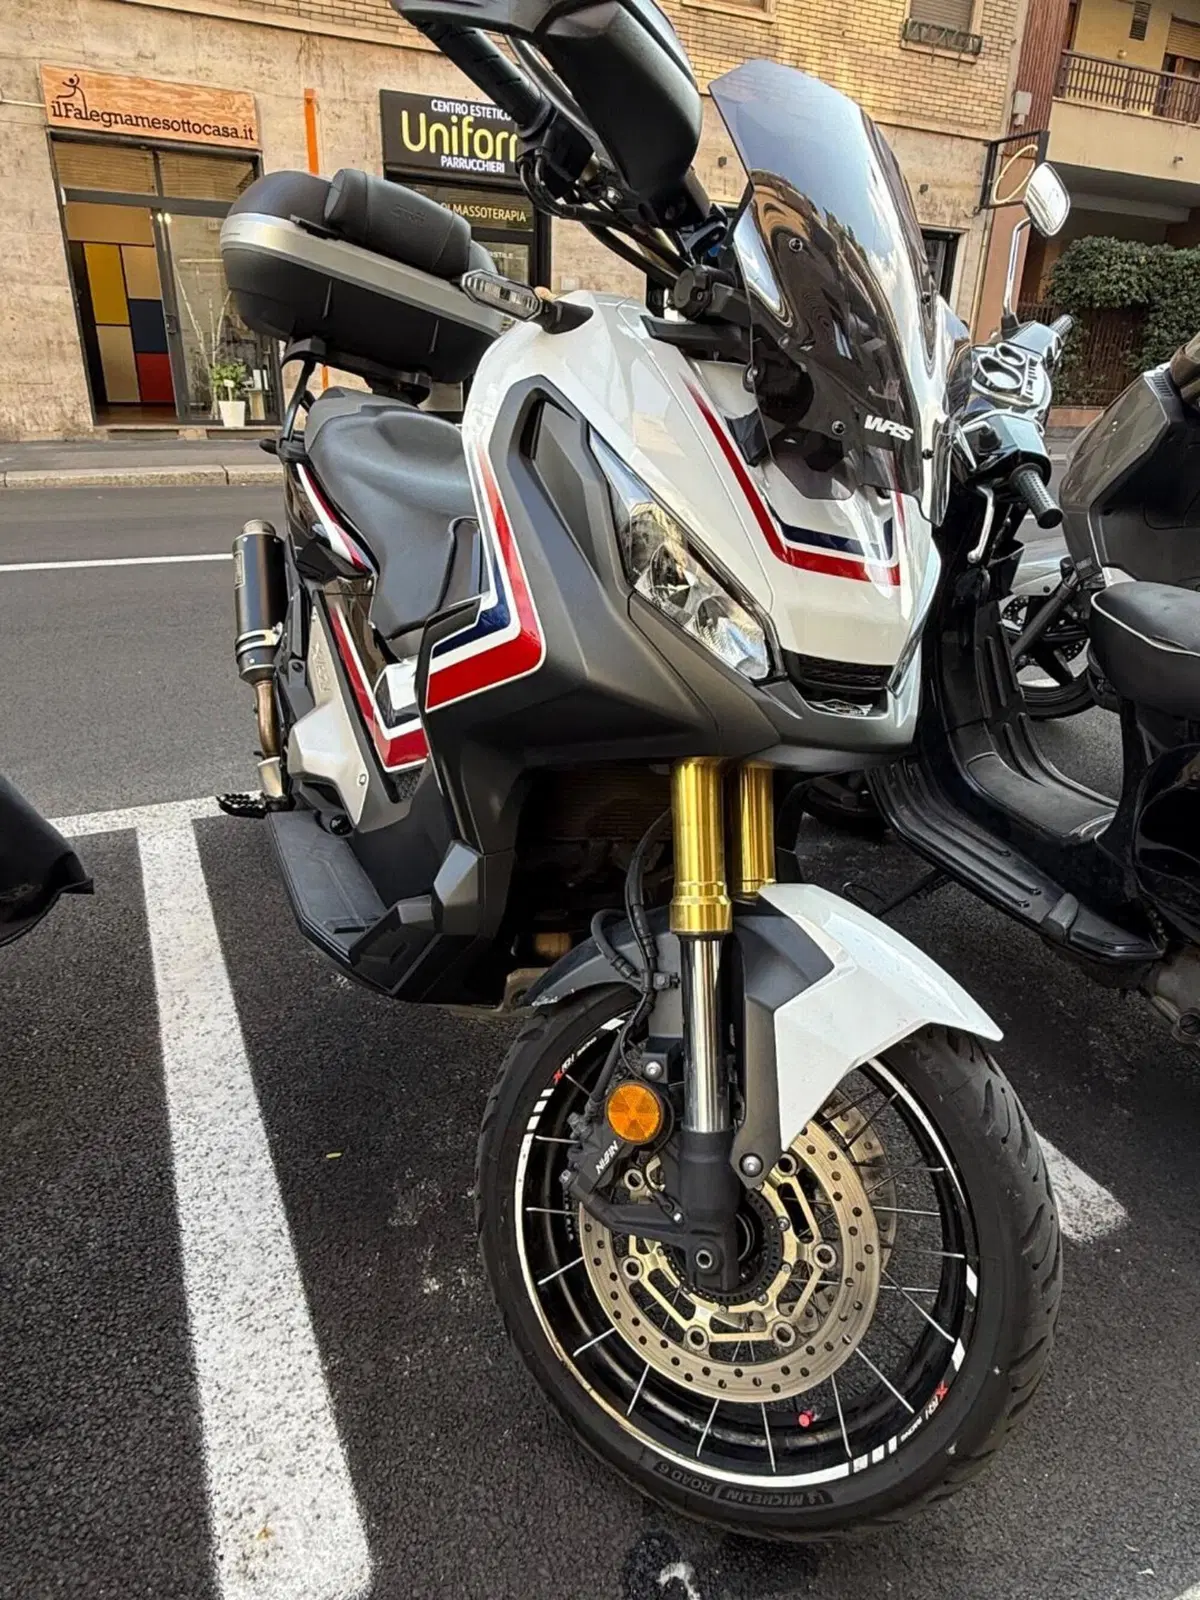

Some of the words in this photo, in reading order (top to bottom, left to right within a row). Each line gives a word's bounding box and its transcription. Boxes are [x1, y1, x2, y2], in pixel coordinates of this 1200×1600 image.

[431, 99, 468, 115] CENTRO
[51, 100, 254, 141] ilFalegnamesottocasa.it
[440, 155, 505, 173] PARRUCCHIERI
[453, 203, 526, 222] MASSOTERAPIA
[864, 414, 914, 441] WRS
[671, 1469, 712, 1493] ROAD
[726, 1489, 804, 1507] MICHELIN
